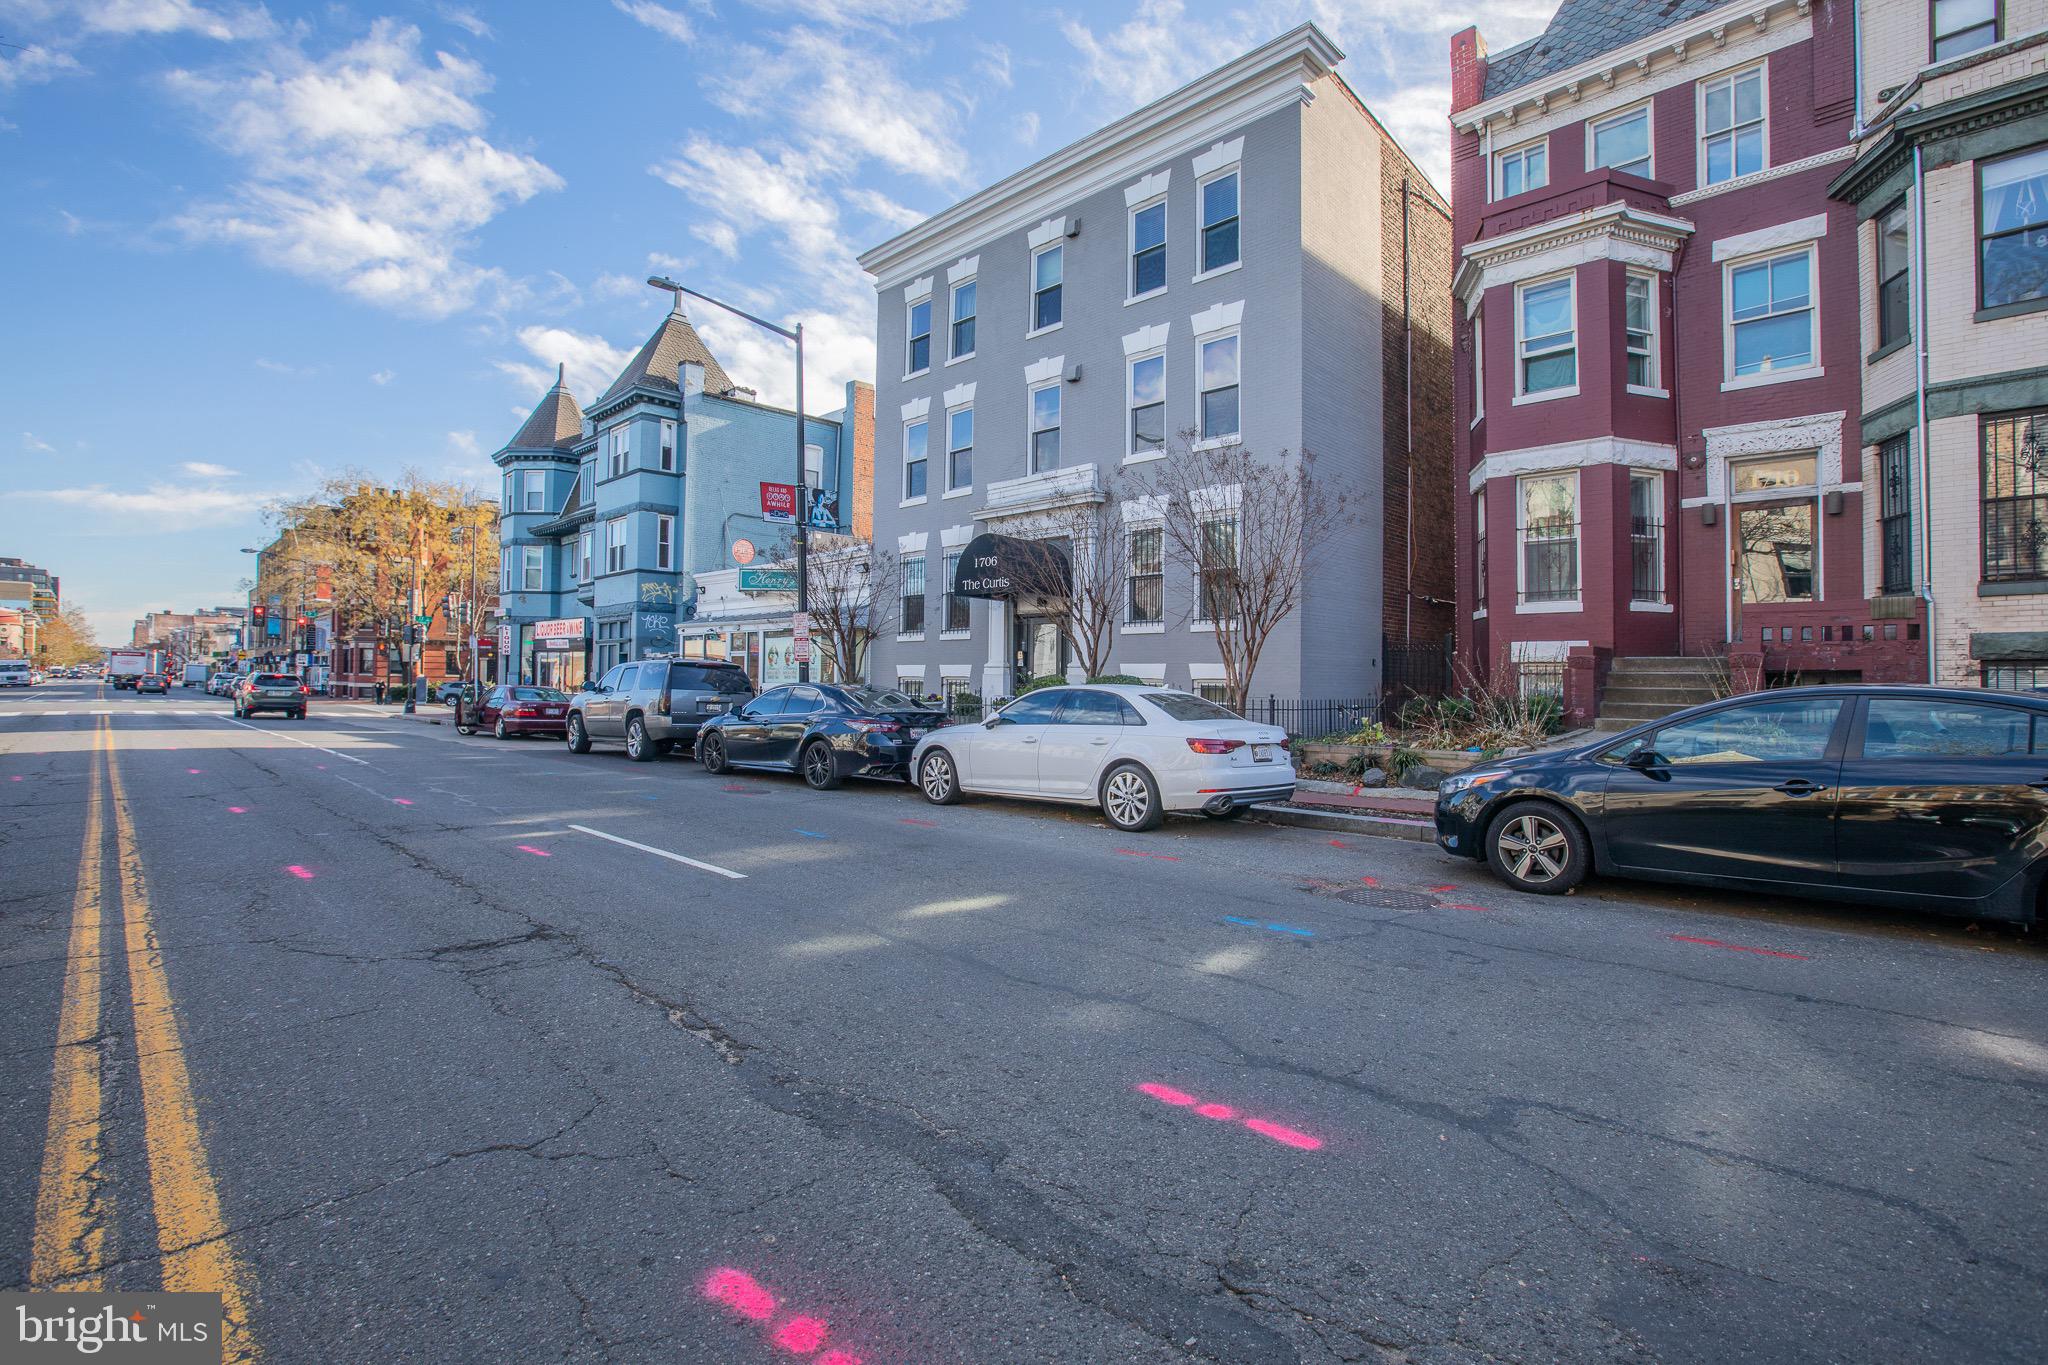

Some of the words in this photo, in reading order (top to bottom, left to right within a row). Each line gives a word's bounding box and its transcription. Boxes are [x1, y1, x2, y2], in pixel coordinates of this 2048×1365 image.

[974, 556, 998, 568] 1706
[962, 579, 981, 590] The
[982, 577, 1010, 589] Curtis
